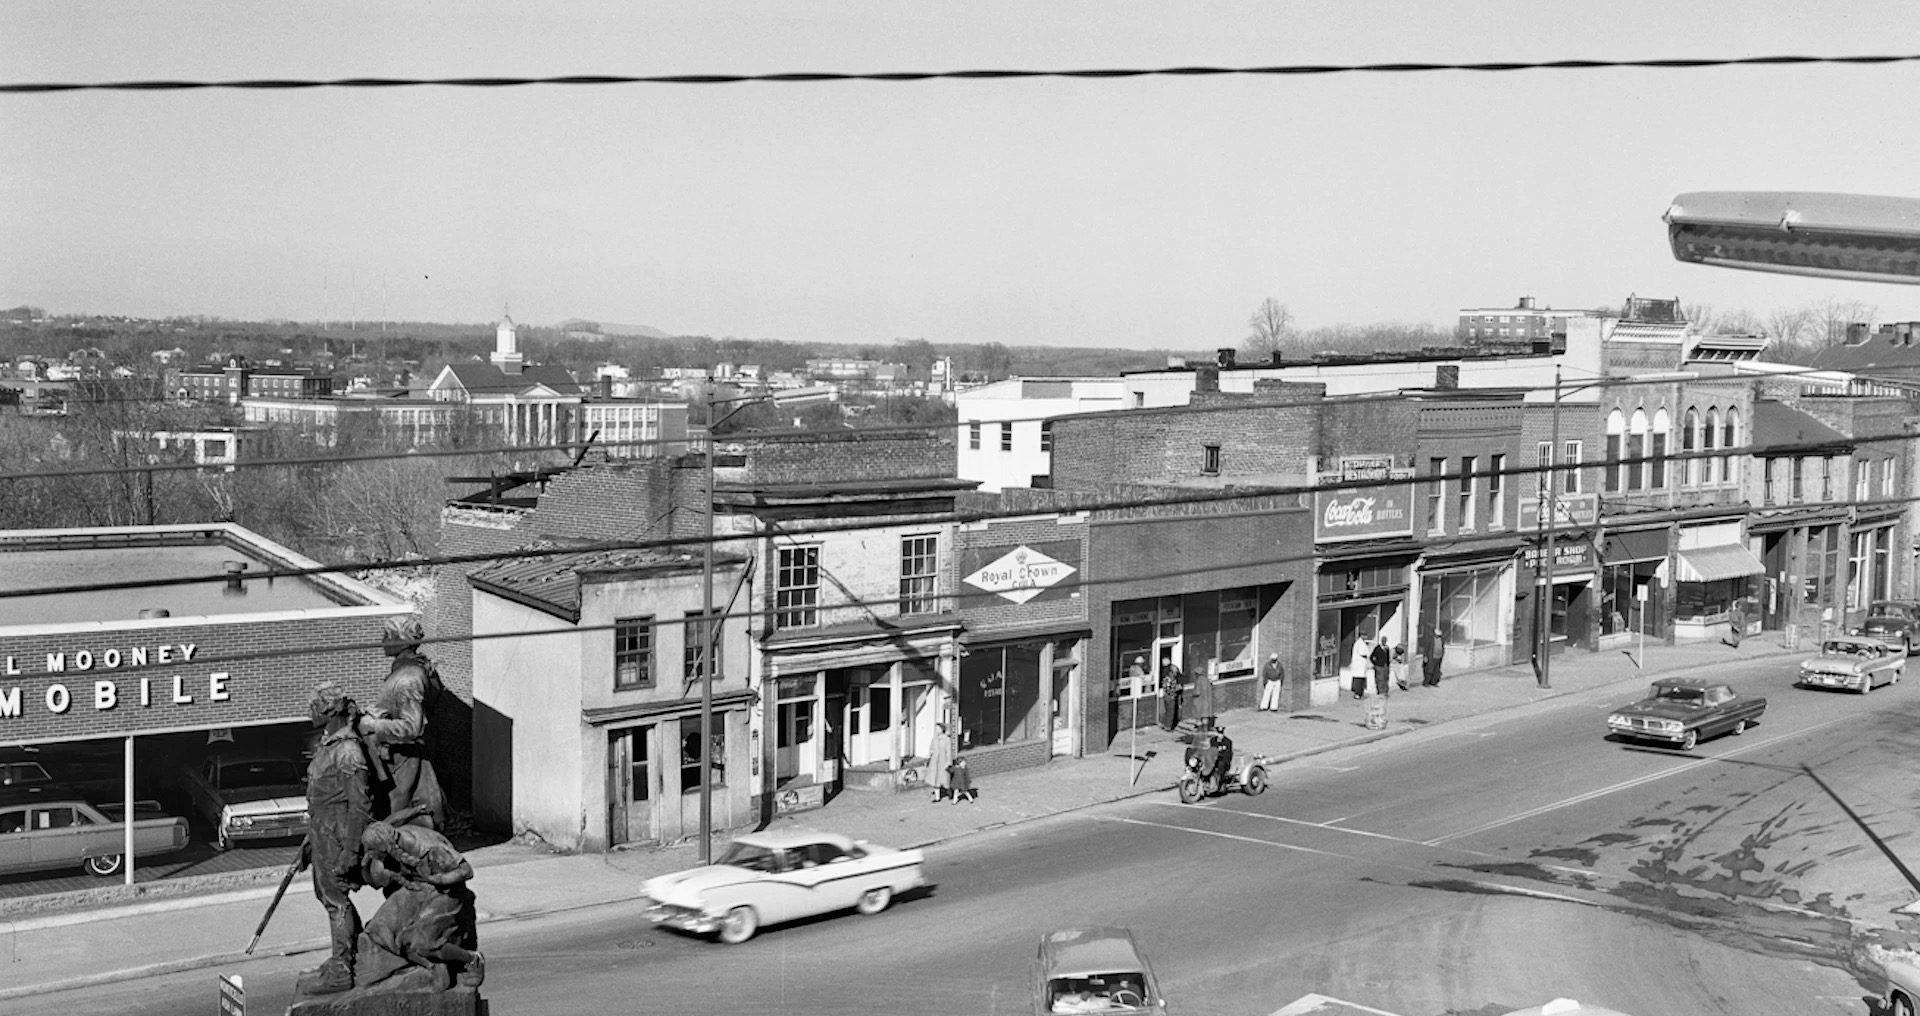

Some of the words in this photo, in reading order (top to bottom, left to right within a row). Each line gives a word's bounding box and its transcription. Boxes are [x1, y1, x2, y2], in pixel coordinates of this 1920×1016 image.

[1324, 497, 1376, 528] Coca-Cola
[1376, 509, 1403, 520] BOTTLES
[1564, 545, 1587, 555] SHOP
[981, 569, 1012, 585] Royal
[1019, 566, 1058, 579] Crown
[47, 643, 196, 672] MOONEY
[0, 672, 230, 717] MOBILE
